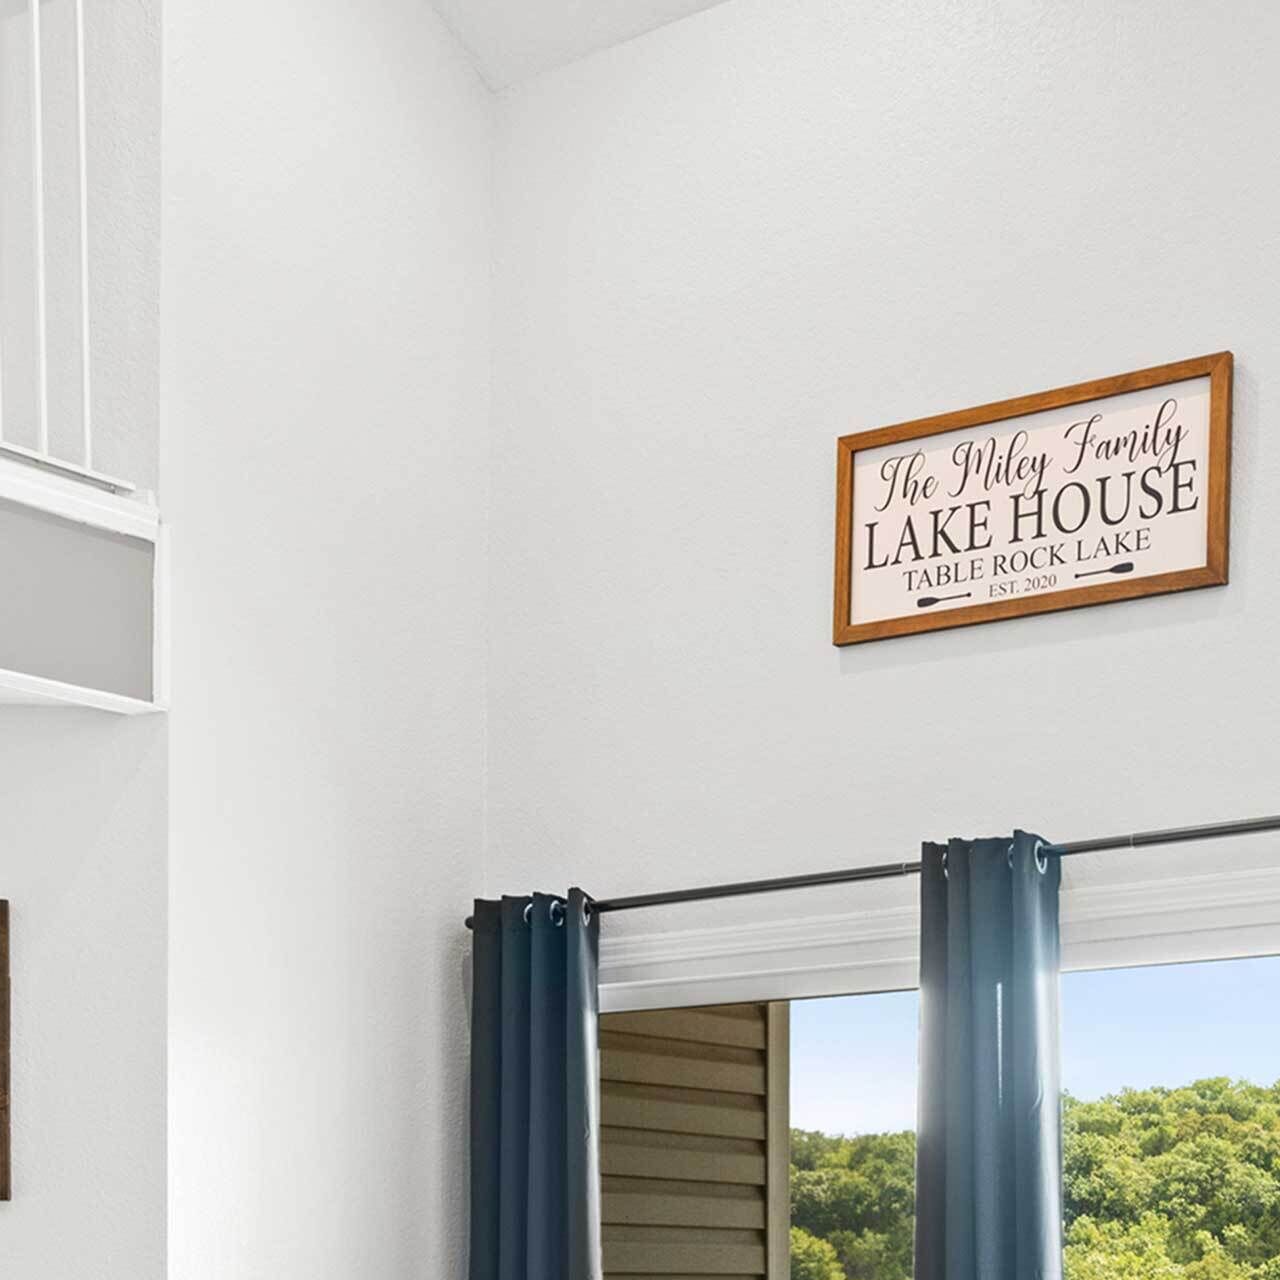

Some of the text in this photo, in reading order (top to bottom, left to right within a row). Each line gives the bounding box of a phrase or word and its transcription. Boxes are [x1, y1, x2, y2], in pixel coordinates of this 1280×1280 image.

[873, 398, 1189, 512] The Miley Family
[863, 459, 1199, 571] LAKE HOUSE
[902, 527, 1151, 592] TABLE ROCK LAKE
[988, 574, 1057, 598] EST. 2020
